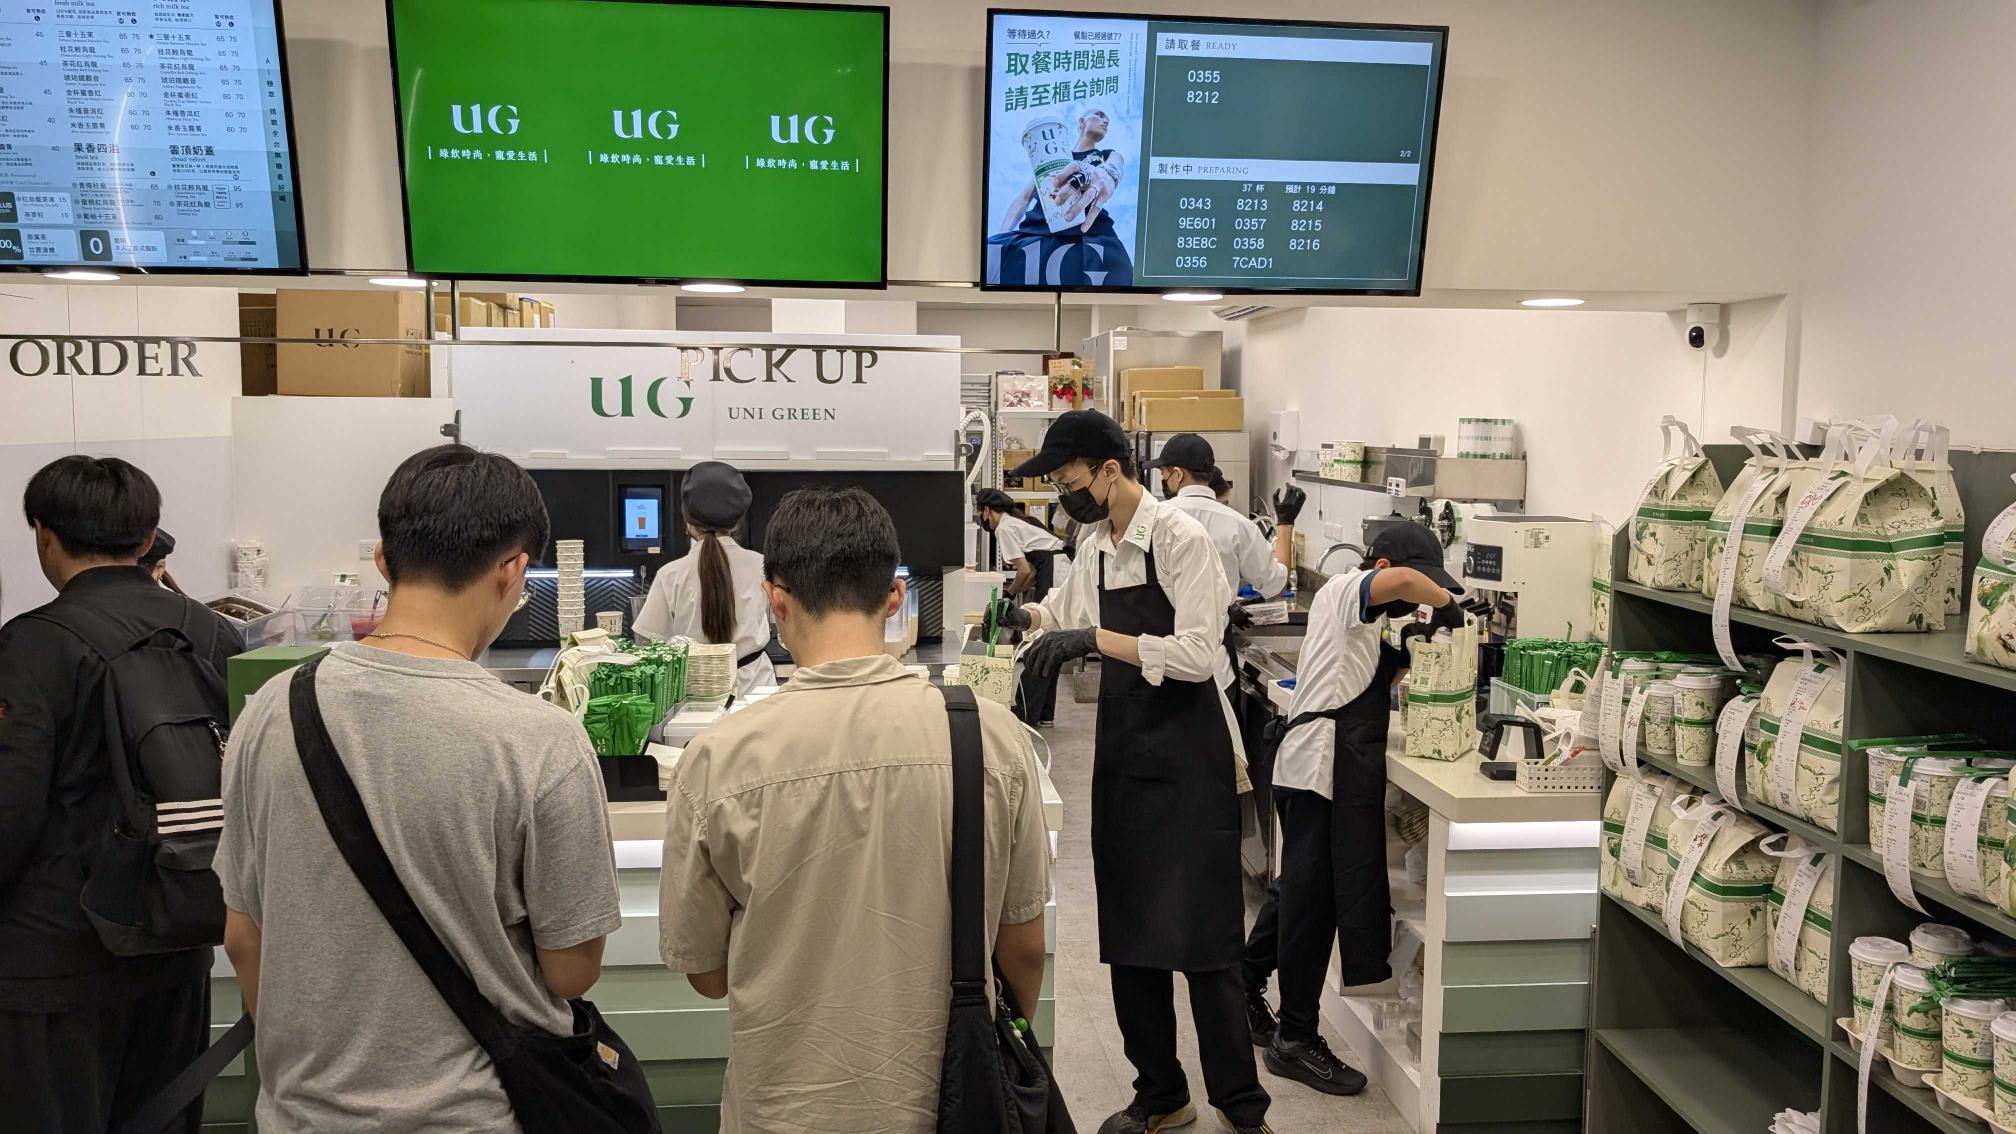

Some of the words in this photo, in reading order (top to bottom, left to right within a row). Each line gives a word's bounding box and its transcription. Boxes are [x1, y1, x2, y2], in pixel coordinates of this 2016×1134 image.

[1164, 38, 1201, 51] 請取餐
[1206, 41, 1238, 51] READY
[1005, 49, 1120, 77] 取餐時間過長
[1188, 70, 1221, 83] 0355
[1004, 75, 1119, 113] 請至櫃台詢問
[1186, 91, 1219, 104] 8212
[451, 104, 520, 135] UG
[612, 110, 680, 140] UG
[770, 114, 836, 145] UG
[169, 145, 215, 156] 雲頂奶蓋
[1400, 150, 1412, 158] 2/2
[1158, 162, 1193, 175] 製作中
[1198, 165, 1250, 175] PREPARING
[1242, 184, 1253, 193] 37
[1256, 184, 1265, 193] 杯
[1285, 184, 1302, 194] 預計
[1306, 185, 1316, 194] 19
[1319, 185, 1336, 195] 分鐘
[1179, 197, 1212, 210] 0343
[1236, 198, 1268, 211] 8213
[1292, 199, 1324, 212] 8214
[1178, 217, 1216, 230] 9E601
[1235, 218, 1267, 231] 0357
[1291, 219, 1322, 231] 8215
[89, 237, 104, 254] 0
[1177, 236, 1217, 249] 83E8C
[1233, 238, 1265, 250] 0358
[1289, 239, 1320, 251] 8216
[1175, 256, 1207, 269] 0356
[1232, 257, 1274, 270] 7CAD1
[9, 338, 204, 378] ORDER
[677, 346, 797, 384] PICK
[812, 349, 879, 384] UP
[590, 374, 695, 419] UG
[728, 407, 764, 420] UNI
[771, 407, 837, 421] GREEN
